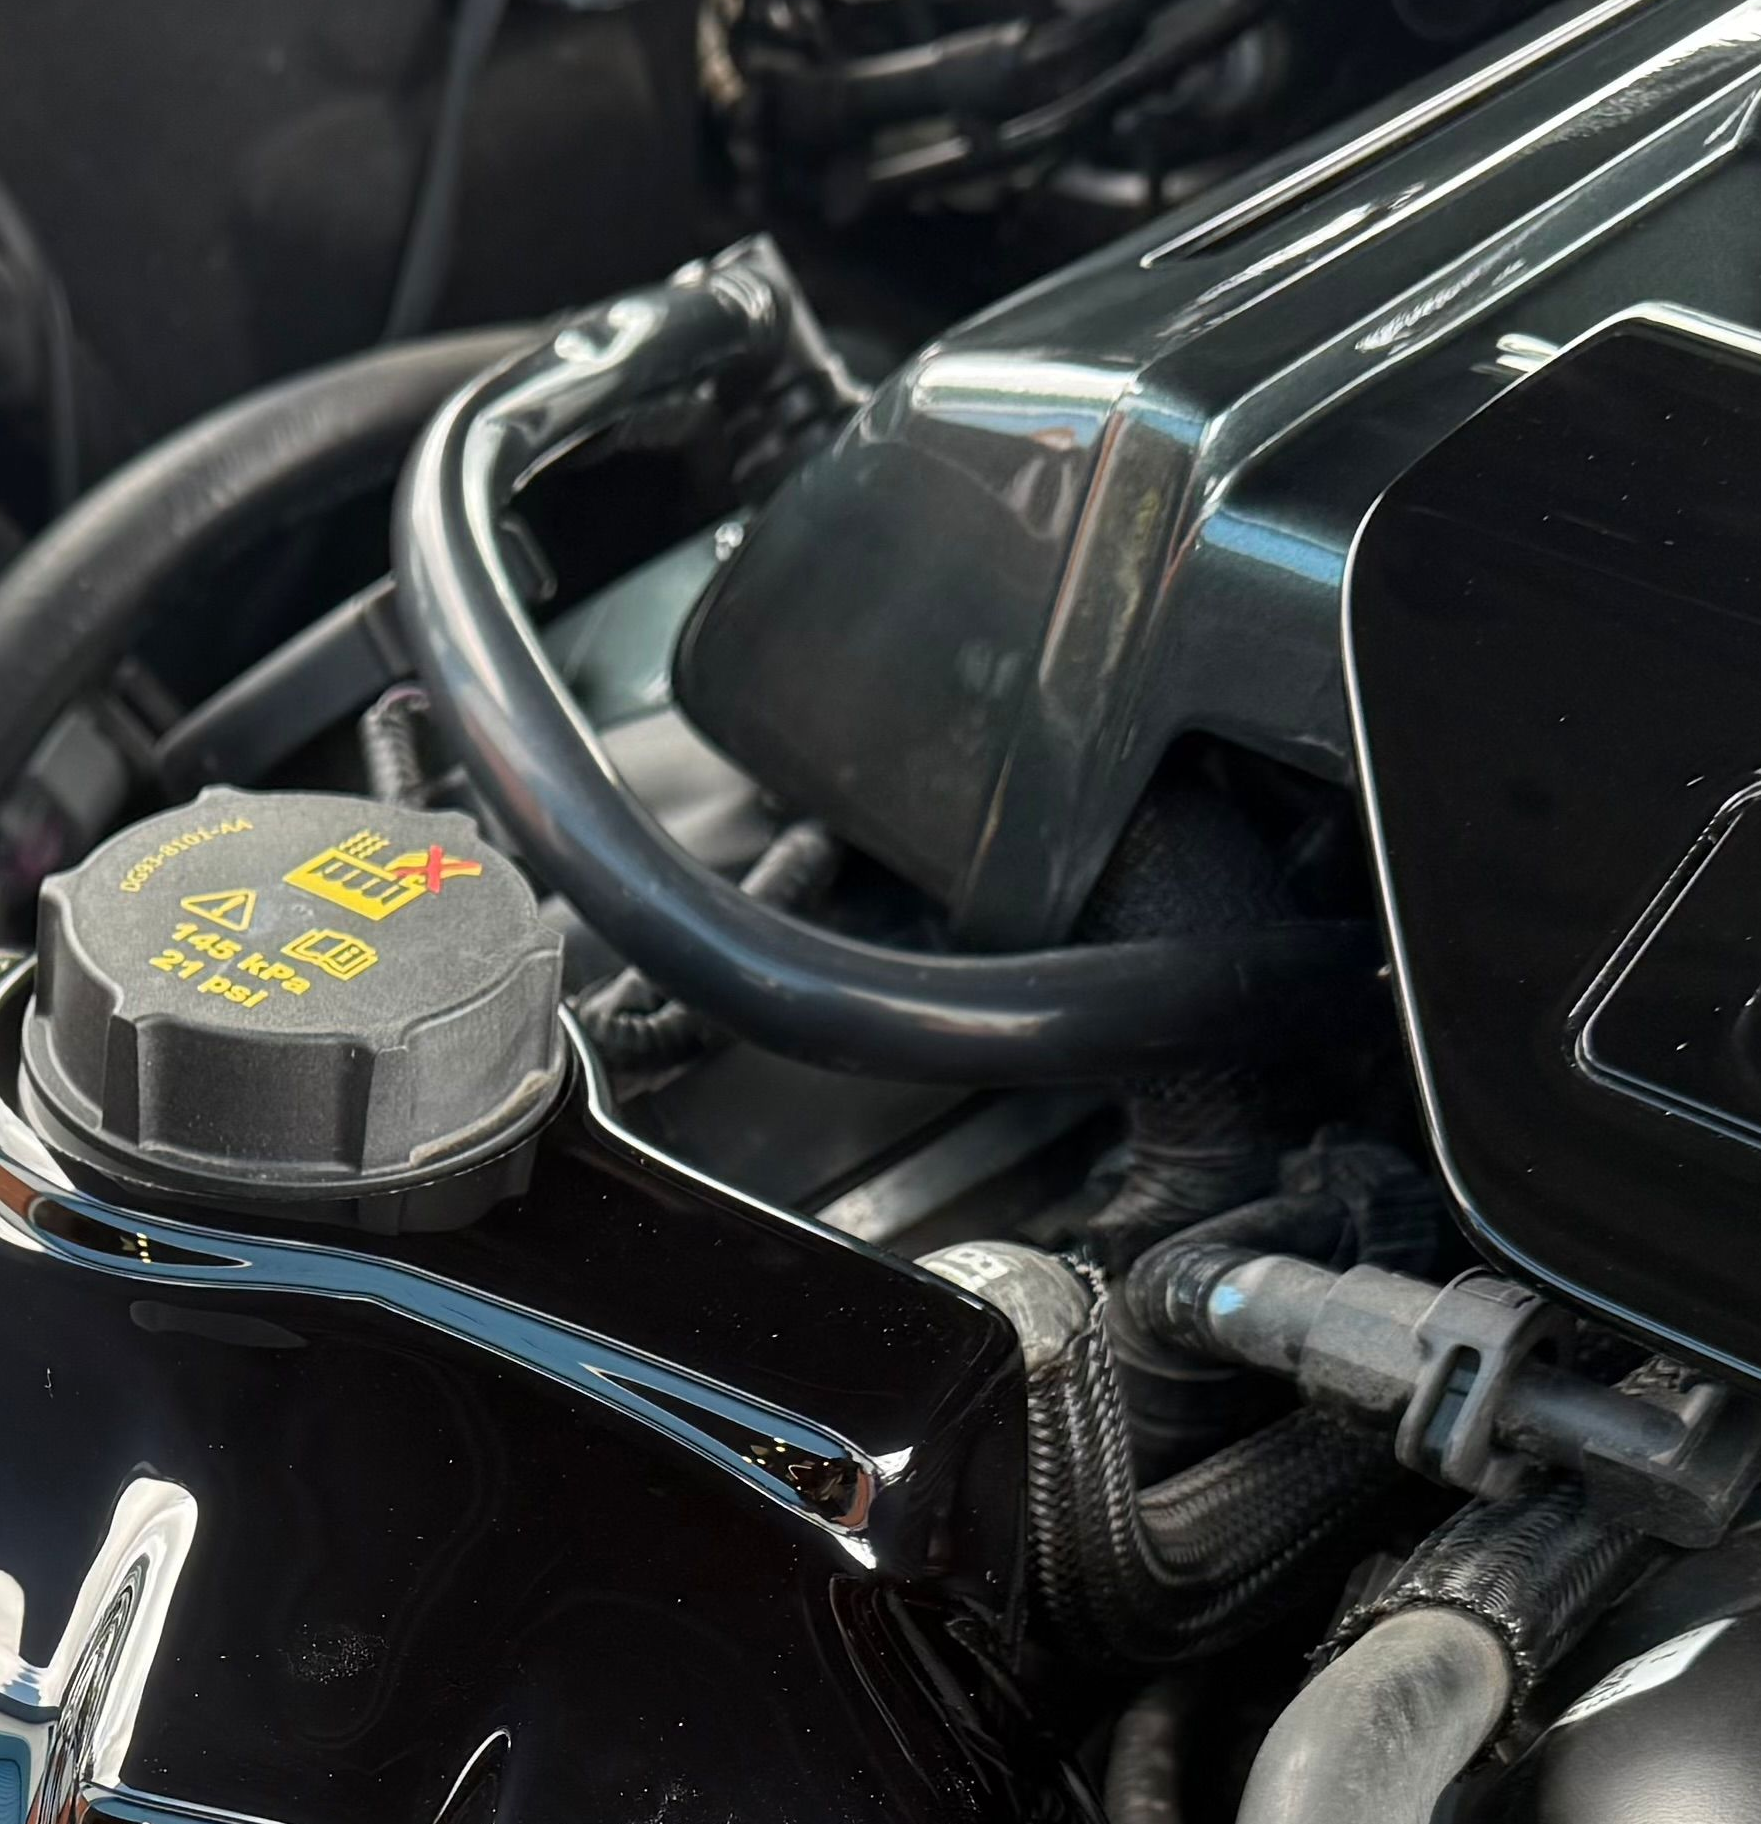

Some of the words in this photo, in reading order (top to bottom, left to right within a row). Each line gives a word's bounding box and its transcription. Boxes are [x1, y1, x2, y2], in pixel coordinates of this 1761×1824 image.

[148, 948, 205, 980] 21
[197, 974, 269, 1008] psi
[172, 922, 243, 961] 145
[237, 952, 311, 995] kPa
